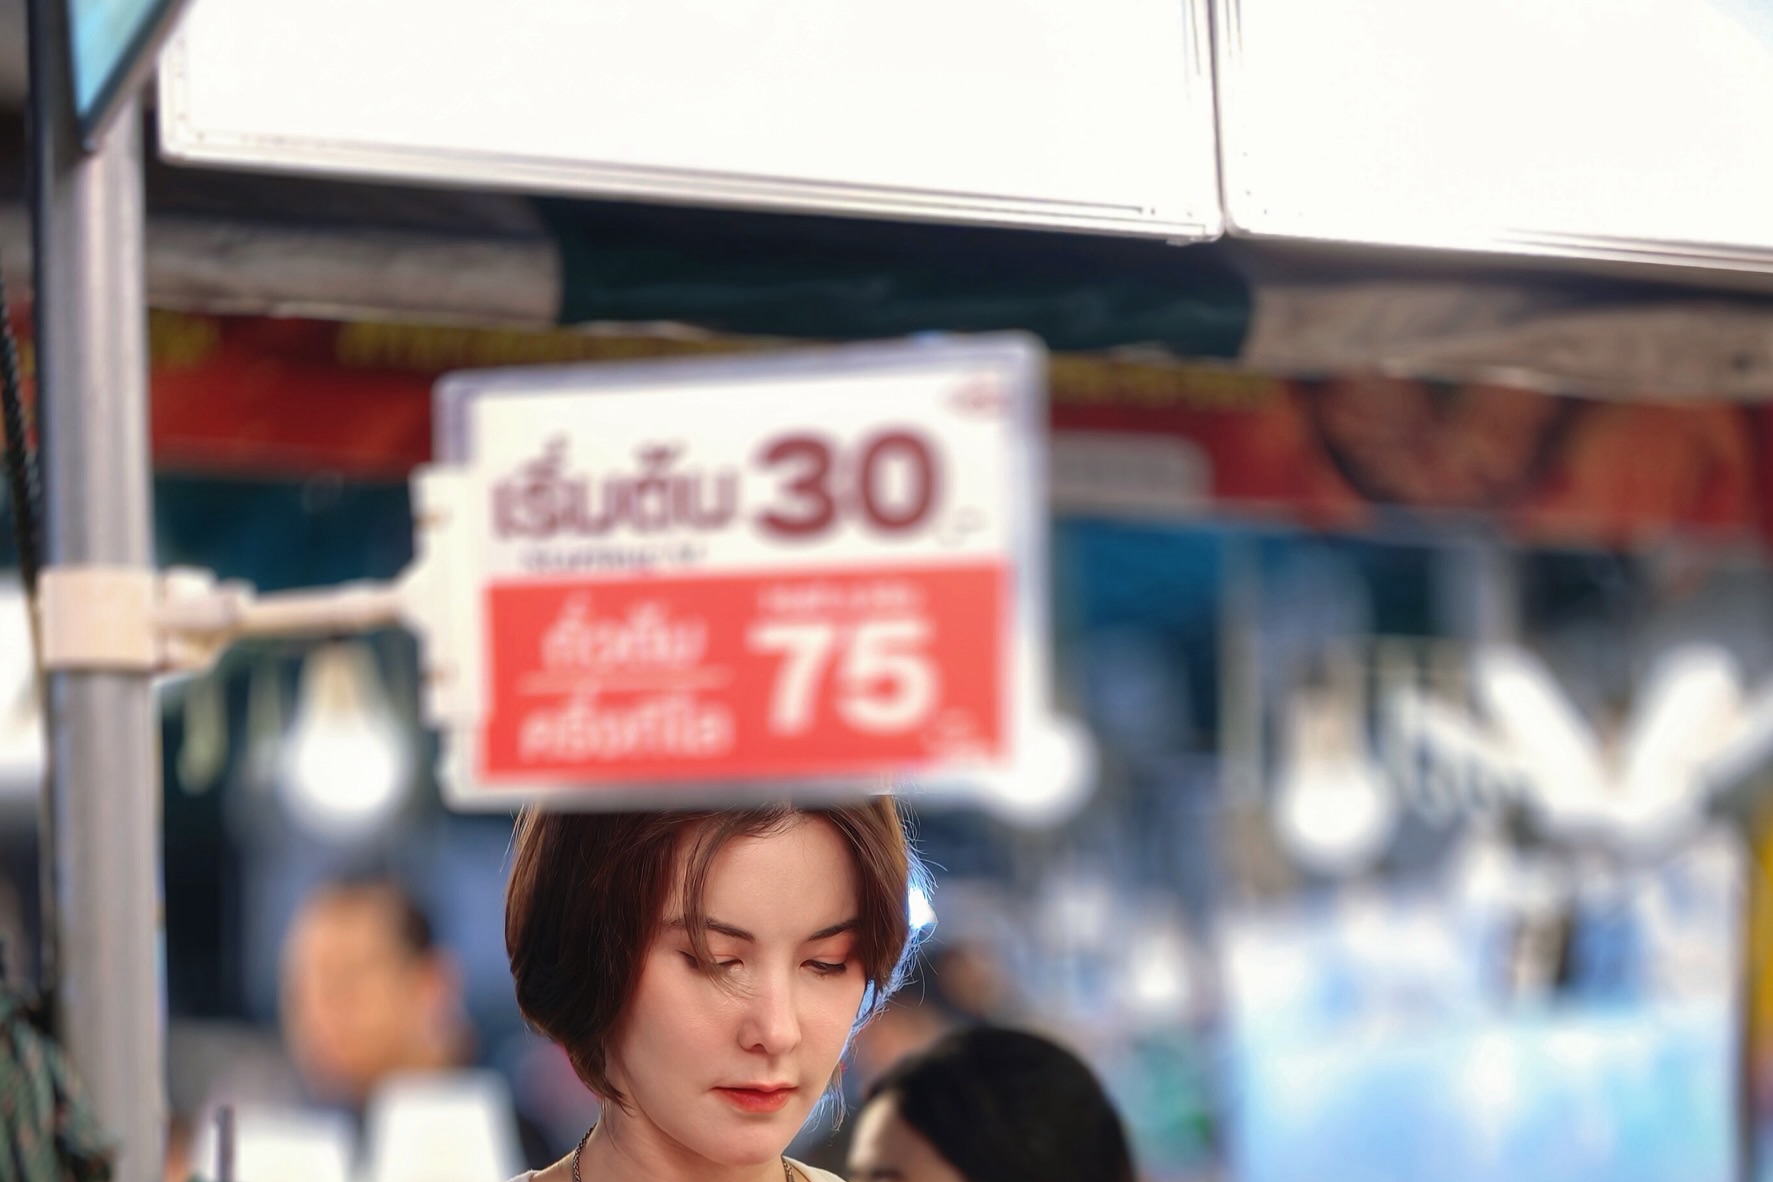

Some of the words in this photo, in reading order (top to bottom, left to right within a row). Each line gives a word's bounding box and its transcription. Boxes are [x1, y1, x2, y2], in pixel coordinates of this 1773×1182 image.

[492, 432, 739, 538] เริ่มต้น
[754, 427, 941, 541] 30
[745, 618, 940, 738] 75
